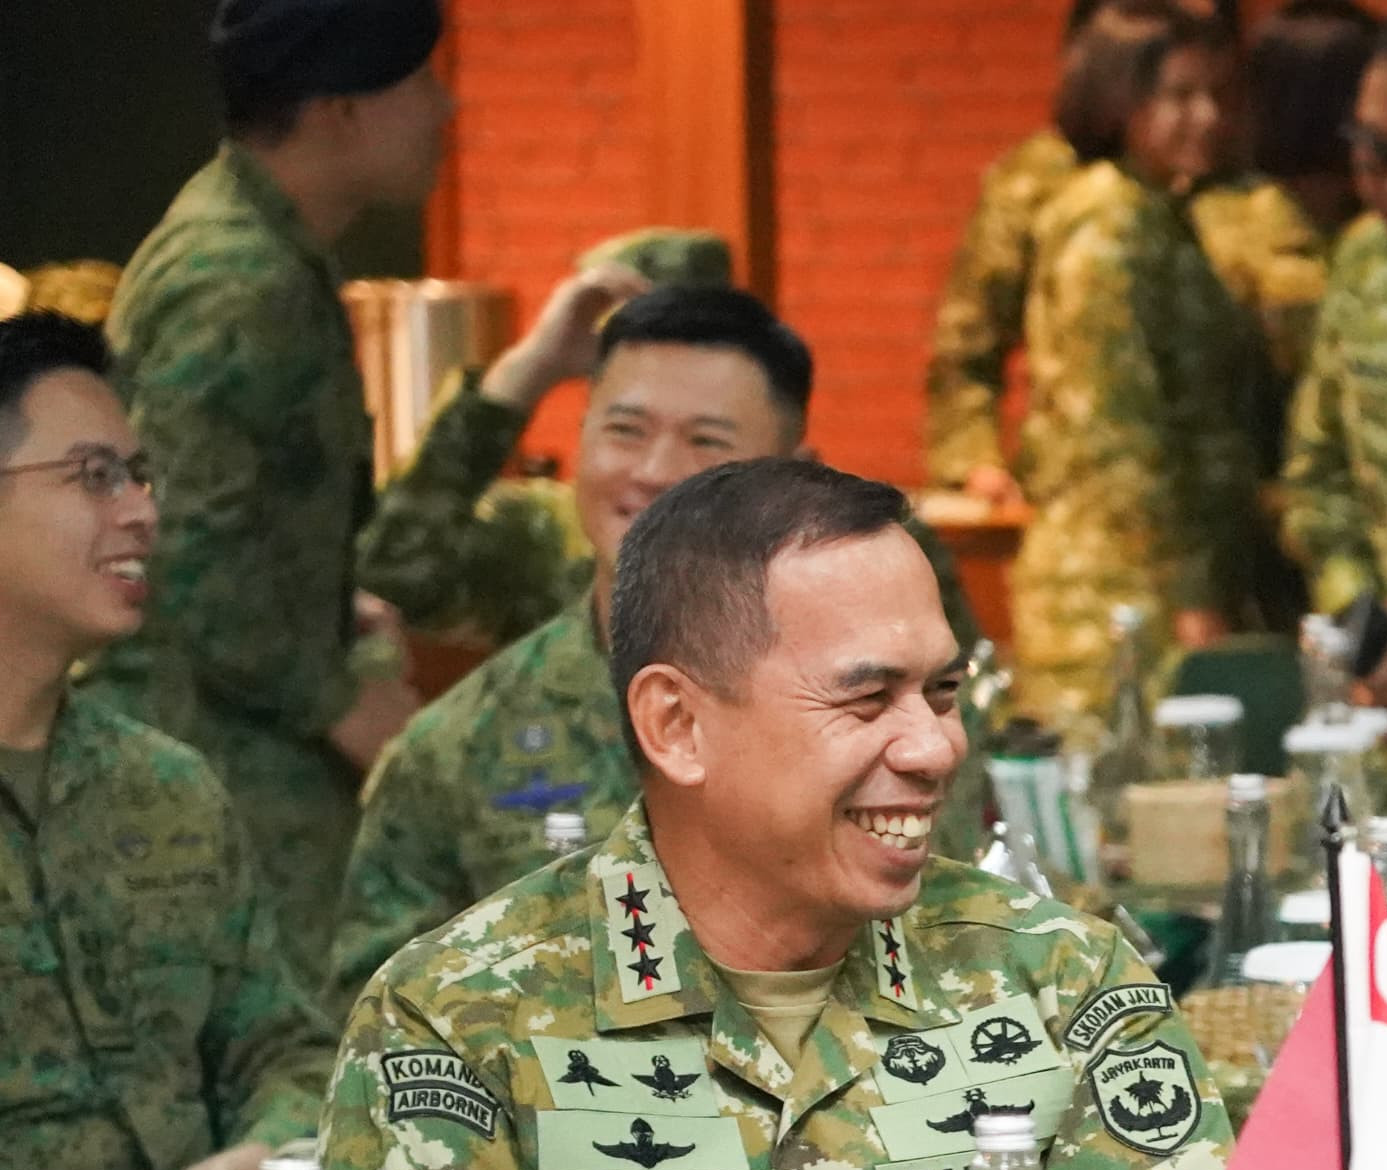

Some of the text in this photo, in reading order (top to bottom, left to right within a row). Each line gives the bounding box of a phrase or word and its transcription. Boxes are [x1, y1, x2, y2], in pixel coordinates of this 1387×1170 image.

[1128, 989, 1162, 1005] JAYA
[1101, 1057, 1176, 1084] JAYAKARTA
[397, 1090, 490, 1127] AIRBORNE
